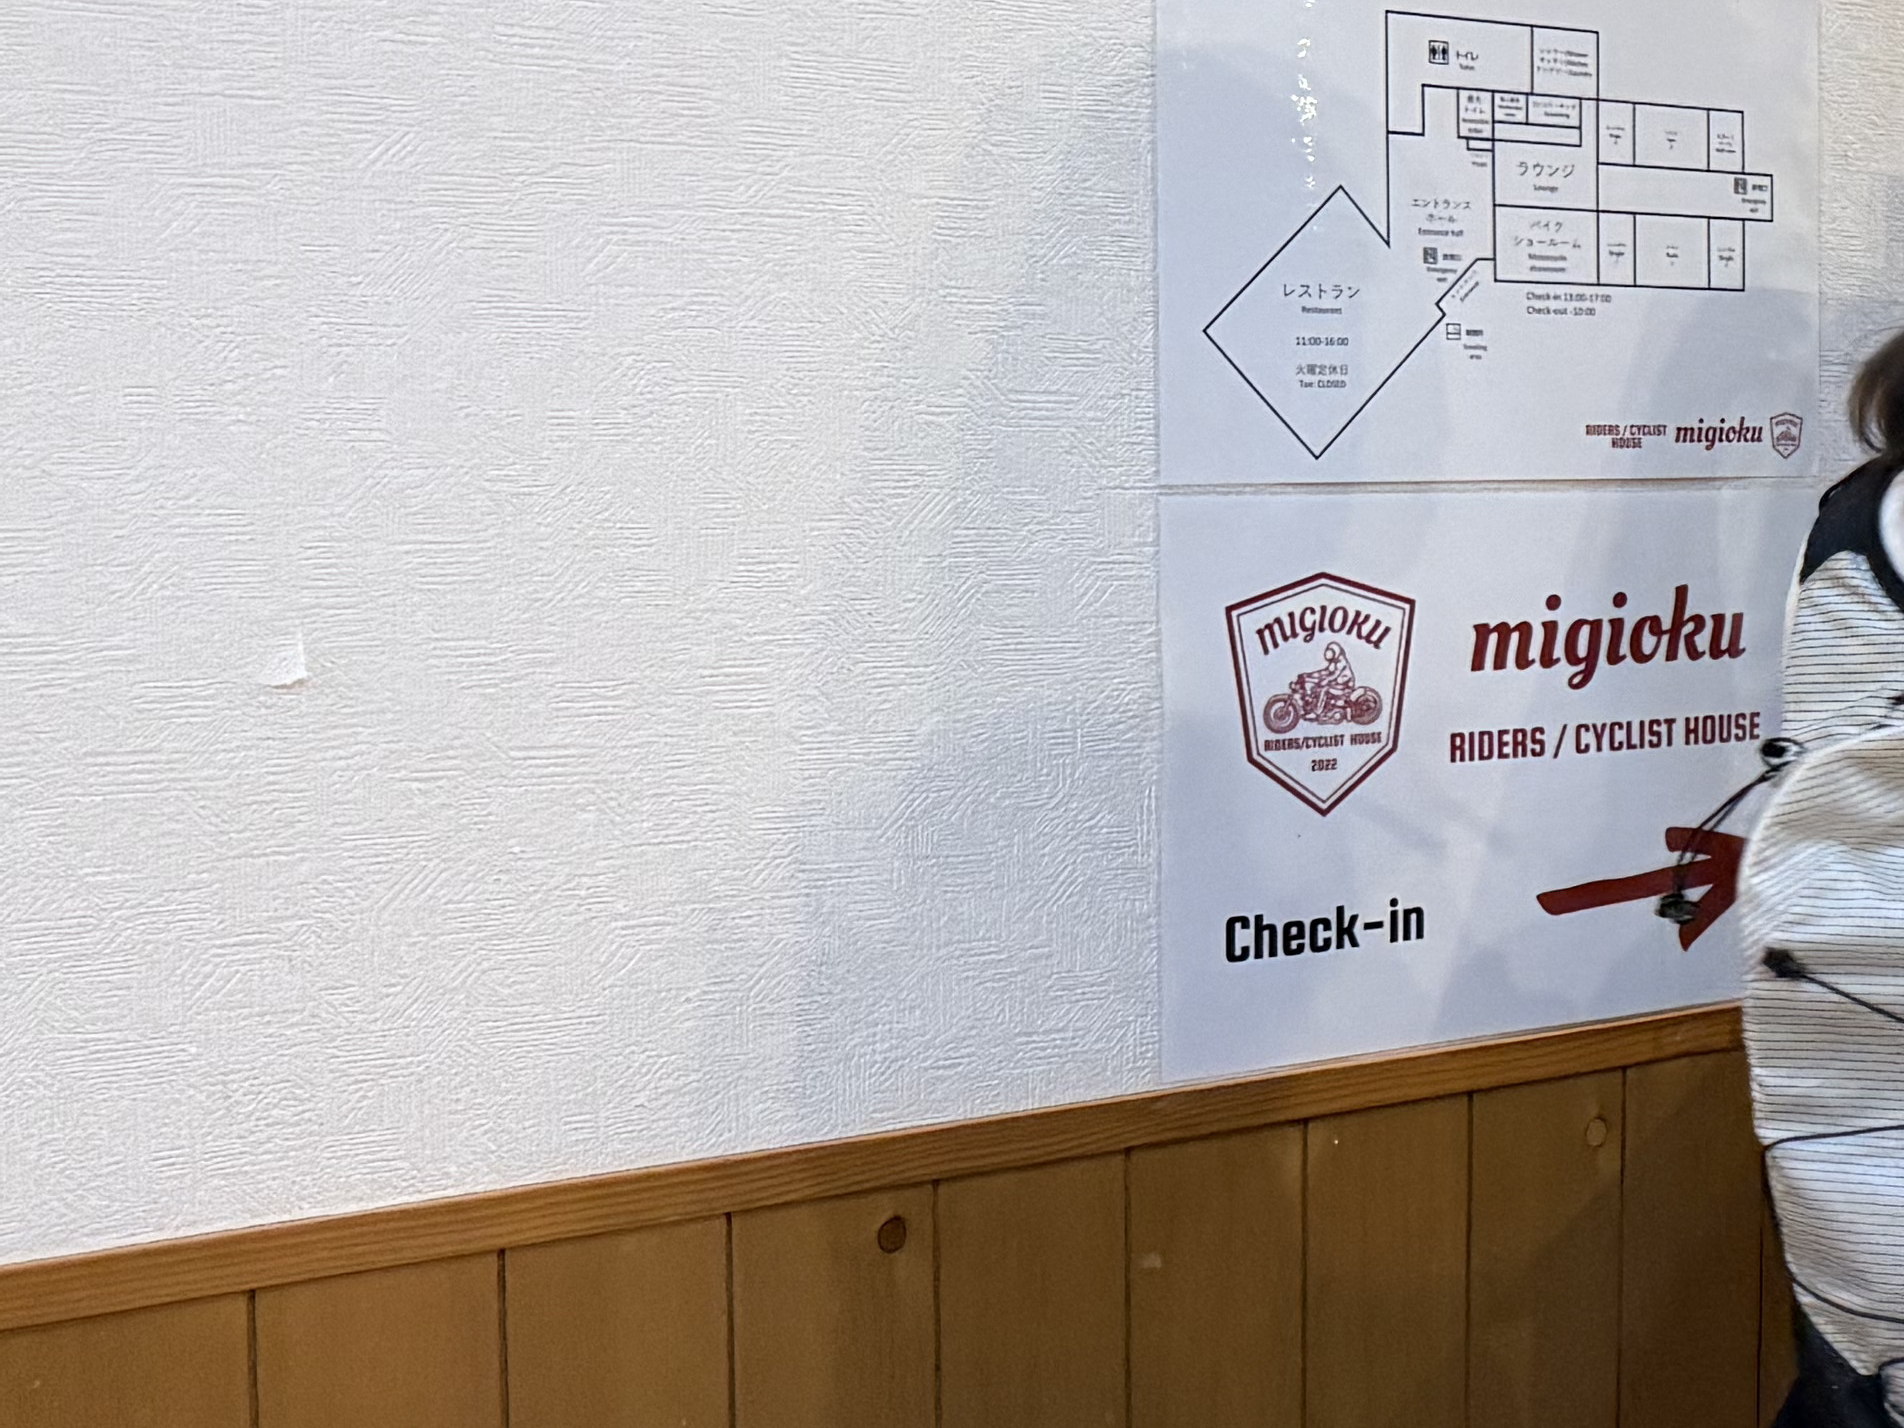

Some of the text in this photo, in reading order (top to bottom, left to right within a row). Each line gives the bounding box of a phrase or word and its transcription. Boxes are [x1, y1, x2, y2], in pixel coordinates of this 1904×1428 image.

[1515, 160, 1576, 179] ラウンジ
[1410, 197, 1472, 211] エントランス
[1529, 219, 1564, 233] バイク
[1513, 235, 1582, 250] ショールーム
[1283, 283, 1361, 300] レストラン
[1295, 363, 1349, 376] 火曜定休日
[1628, 424, 1668, 437] CYCLIST
[1674, 415, 1764, 452] migioku
[1470, 583, 1747, 691] migioku
[1449, 710, 1762, 764] RIDERS / CYCLIST HOUSE
[1222, 897, 1426, 965] Check-in
